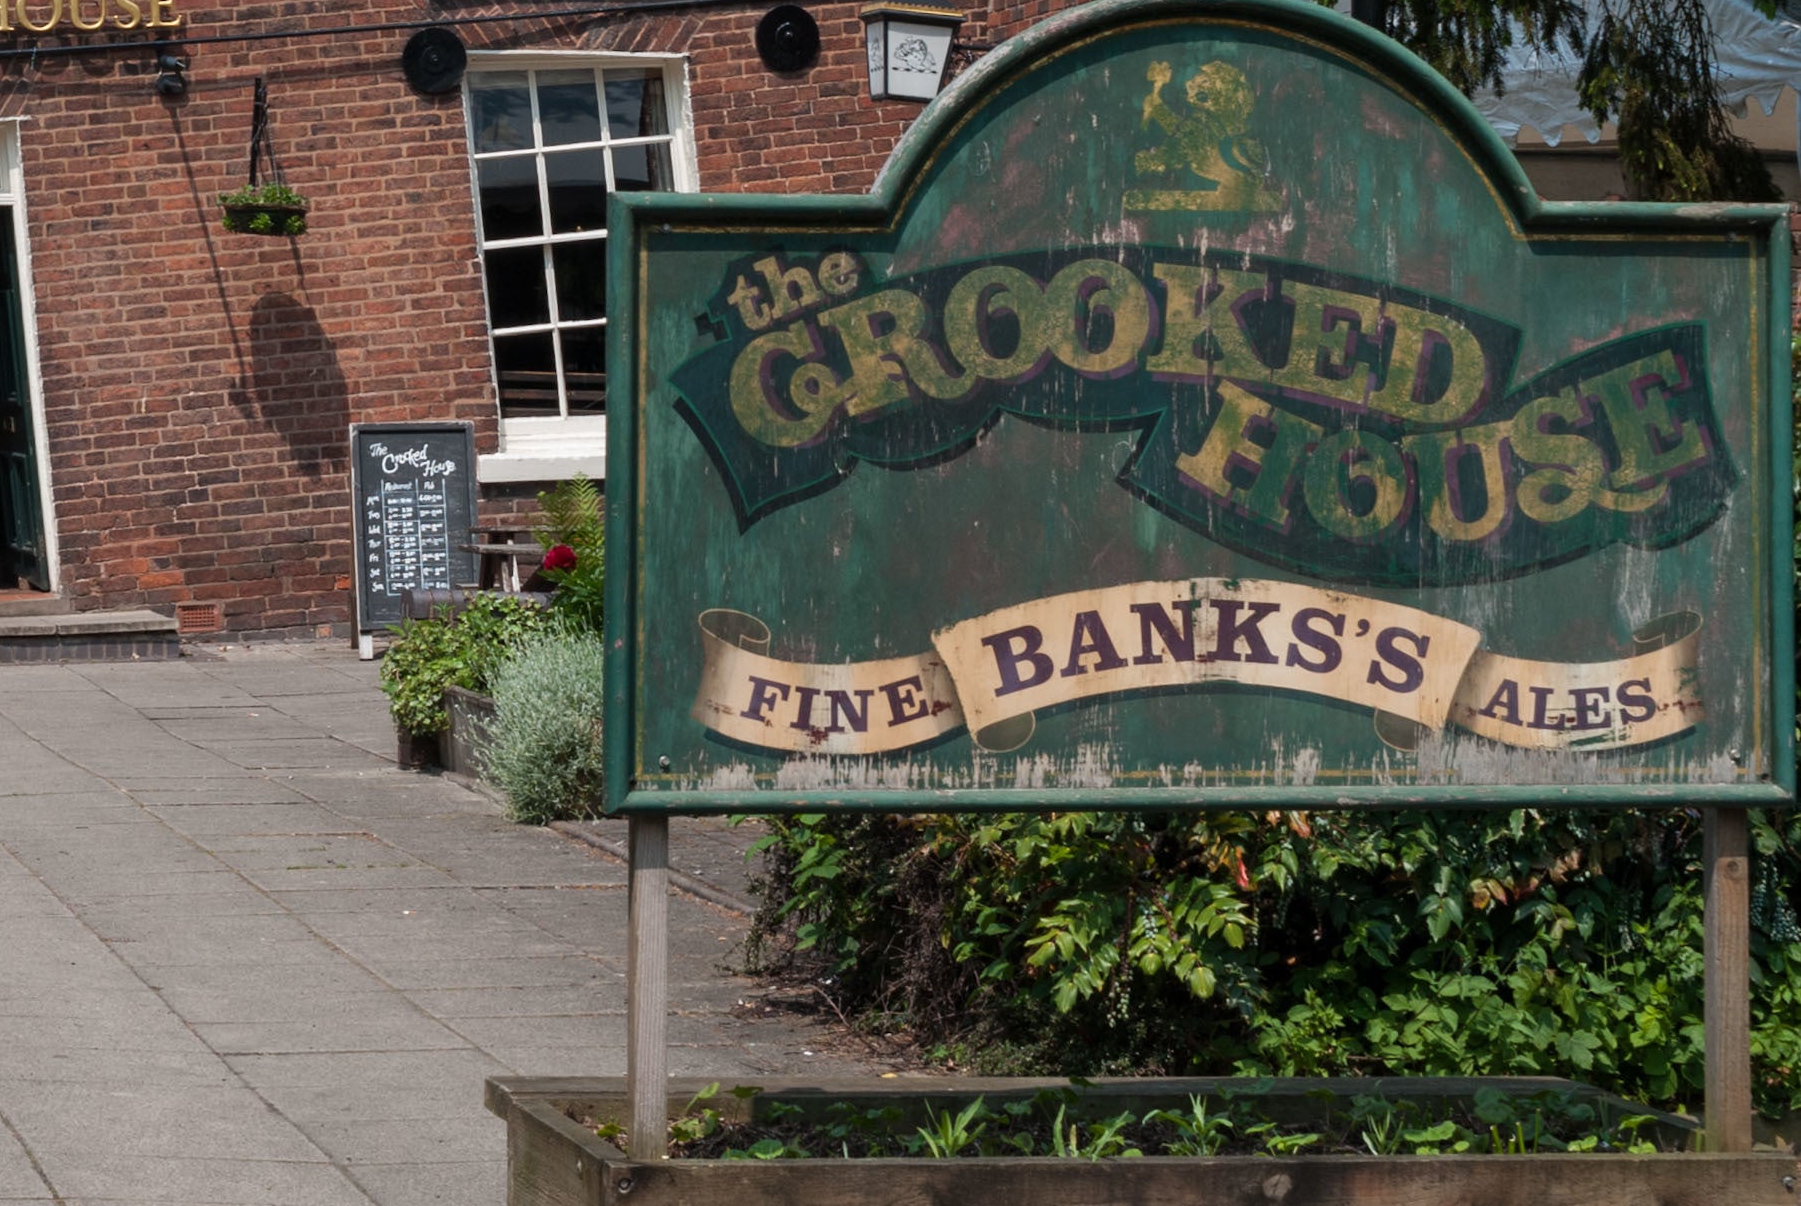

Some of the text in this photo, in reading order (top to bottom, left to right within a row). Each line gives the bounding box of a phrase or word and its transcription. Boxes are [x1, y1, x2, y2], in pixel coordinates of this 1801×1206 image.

[727, 252, 858, 330] the
[730, 258, 1487, 447] CROOKED
[369, 442, 388, 457] The
[382, 443, 428, 473] Crooked
[420, 460, 456, 476] House
[1176, 349, 1710, 541] HOUSE
[739, 599, 1658, 732] FINE BANKS'S ALES
